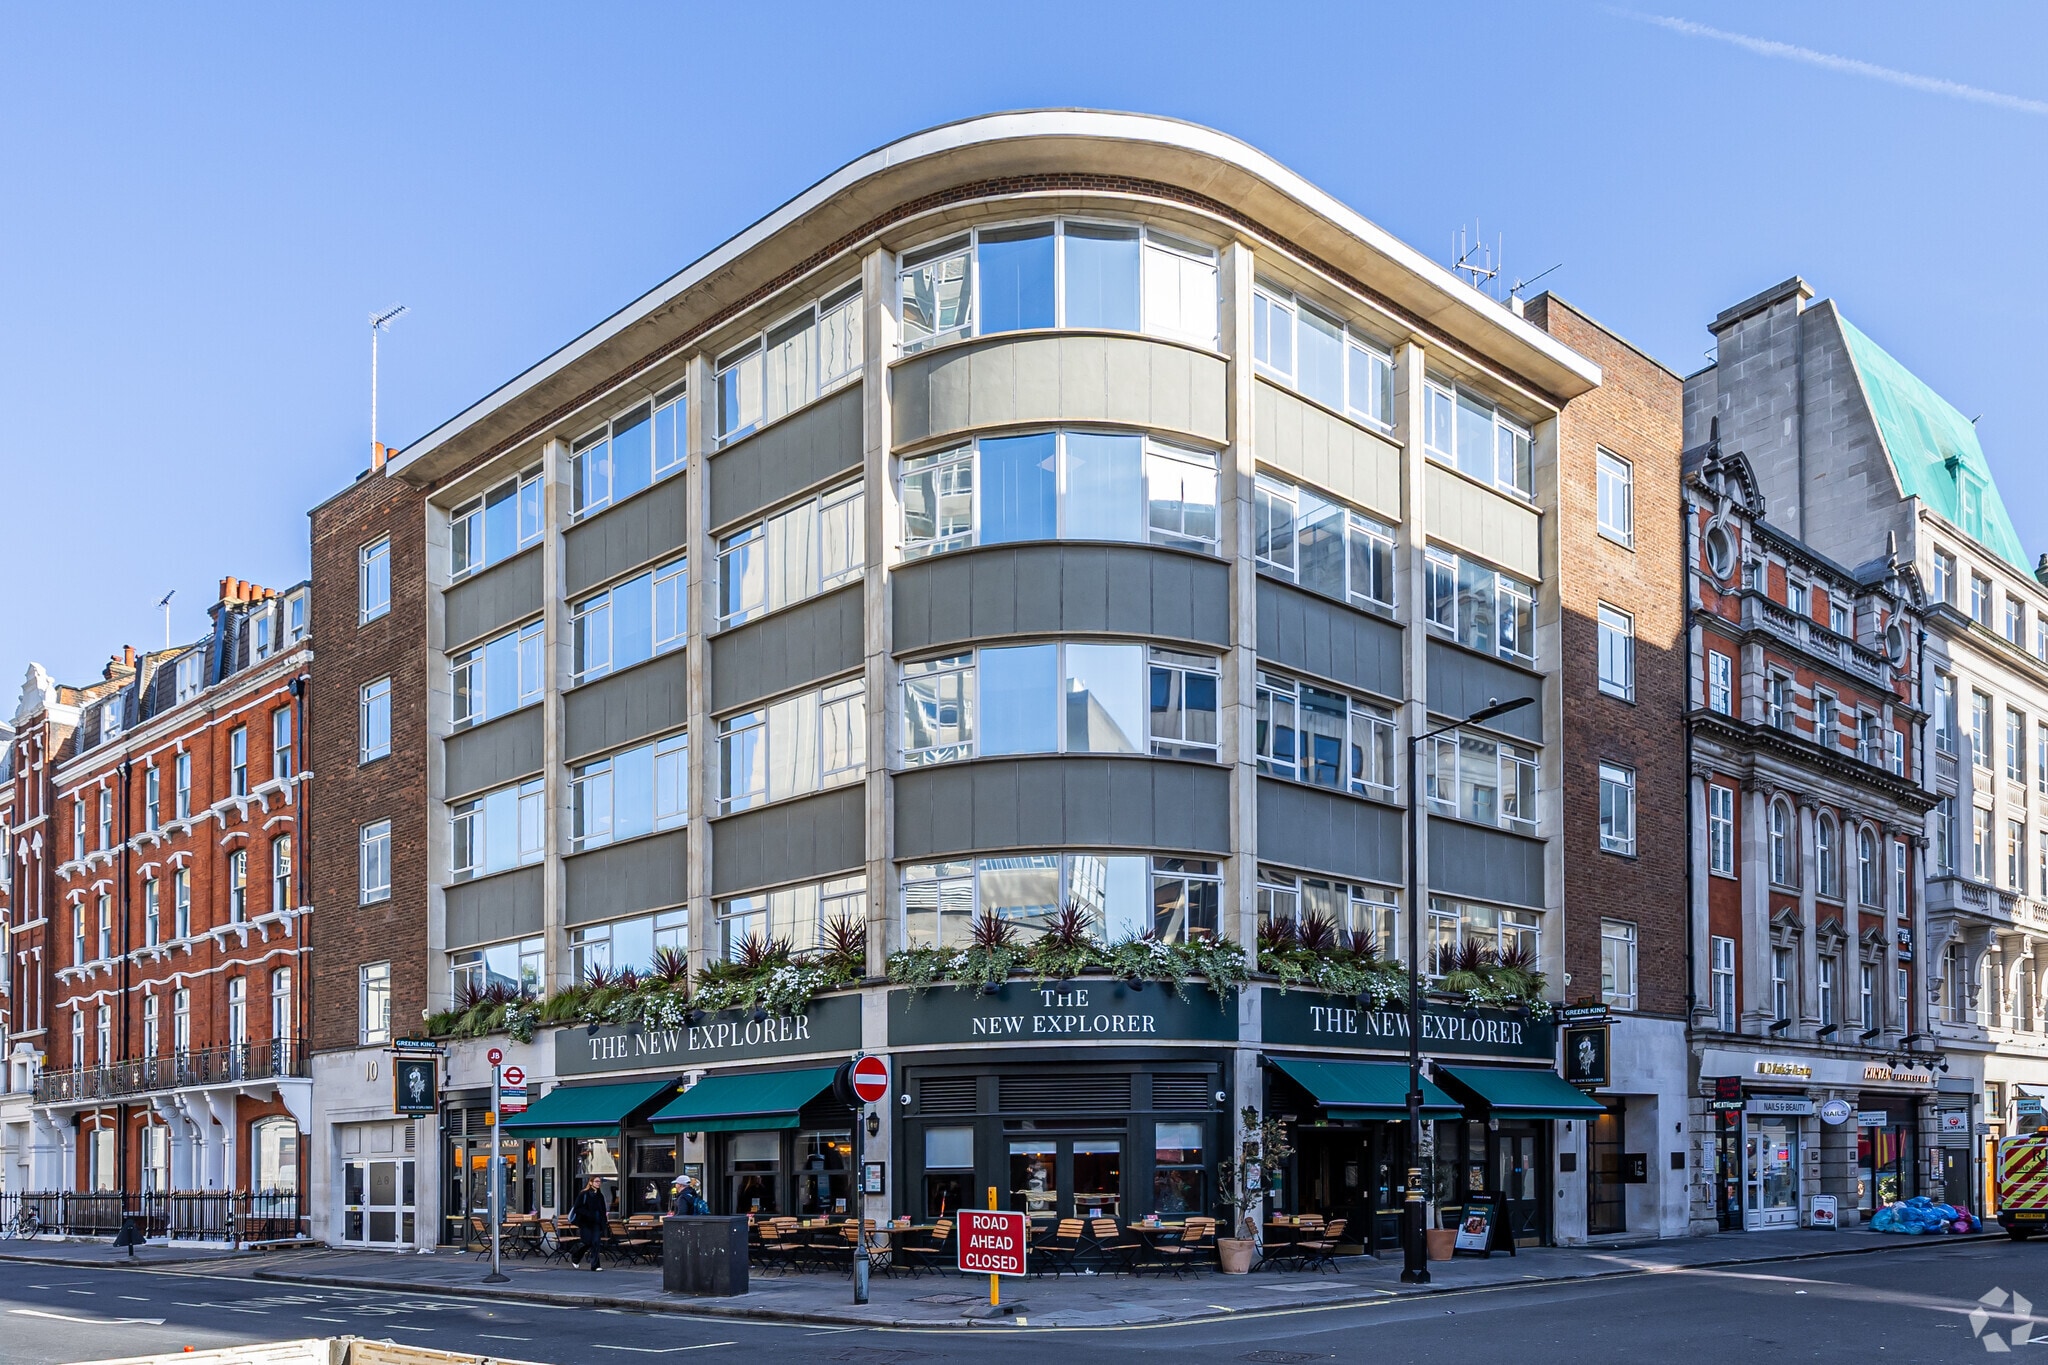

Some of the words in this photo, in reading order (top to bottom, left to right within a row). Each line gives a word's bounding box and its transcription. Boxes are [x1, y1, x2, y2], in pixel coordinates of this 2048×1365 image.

[1040, 989, 1089, 1007] THE
[1565, 1008, 1589, 1016] GREENE
[972, 1016, 1024, 1035] NEW
[1032, 1015, 1156, 1033] EXPLORER
[1310, 1006, 1357, 1034] THE
[1366, 1011, 1411, 1037] NEW
[1421, 1014, 1523, 1045] EXPLORER
[588, 1035, 628, 1060] THE
[635, 1028, 682, 1057] NEW
[688, 1014, 811, 1051] EXPLORER
[366, 1060, 378, 1081] 10
[1864, 1067, 1893, 1080] KINTAN
[1763, 1102, 1780, 1111] NAILS
[1780, 1103, 1785, 1111] &
[1785, 1103, 1806, 1111] BEAUTY
[973, 1215, 1009, 1231] ROAD
[969, 1234, 1014, 1250] AHEAD
[966, 1253, 1018, 1270] CLOSED
